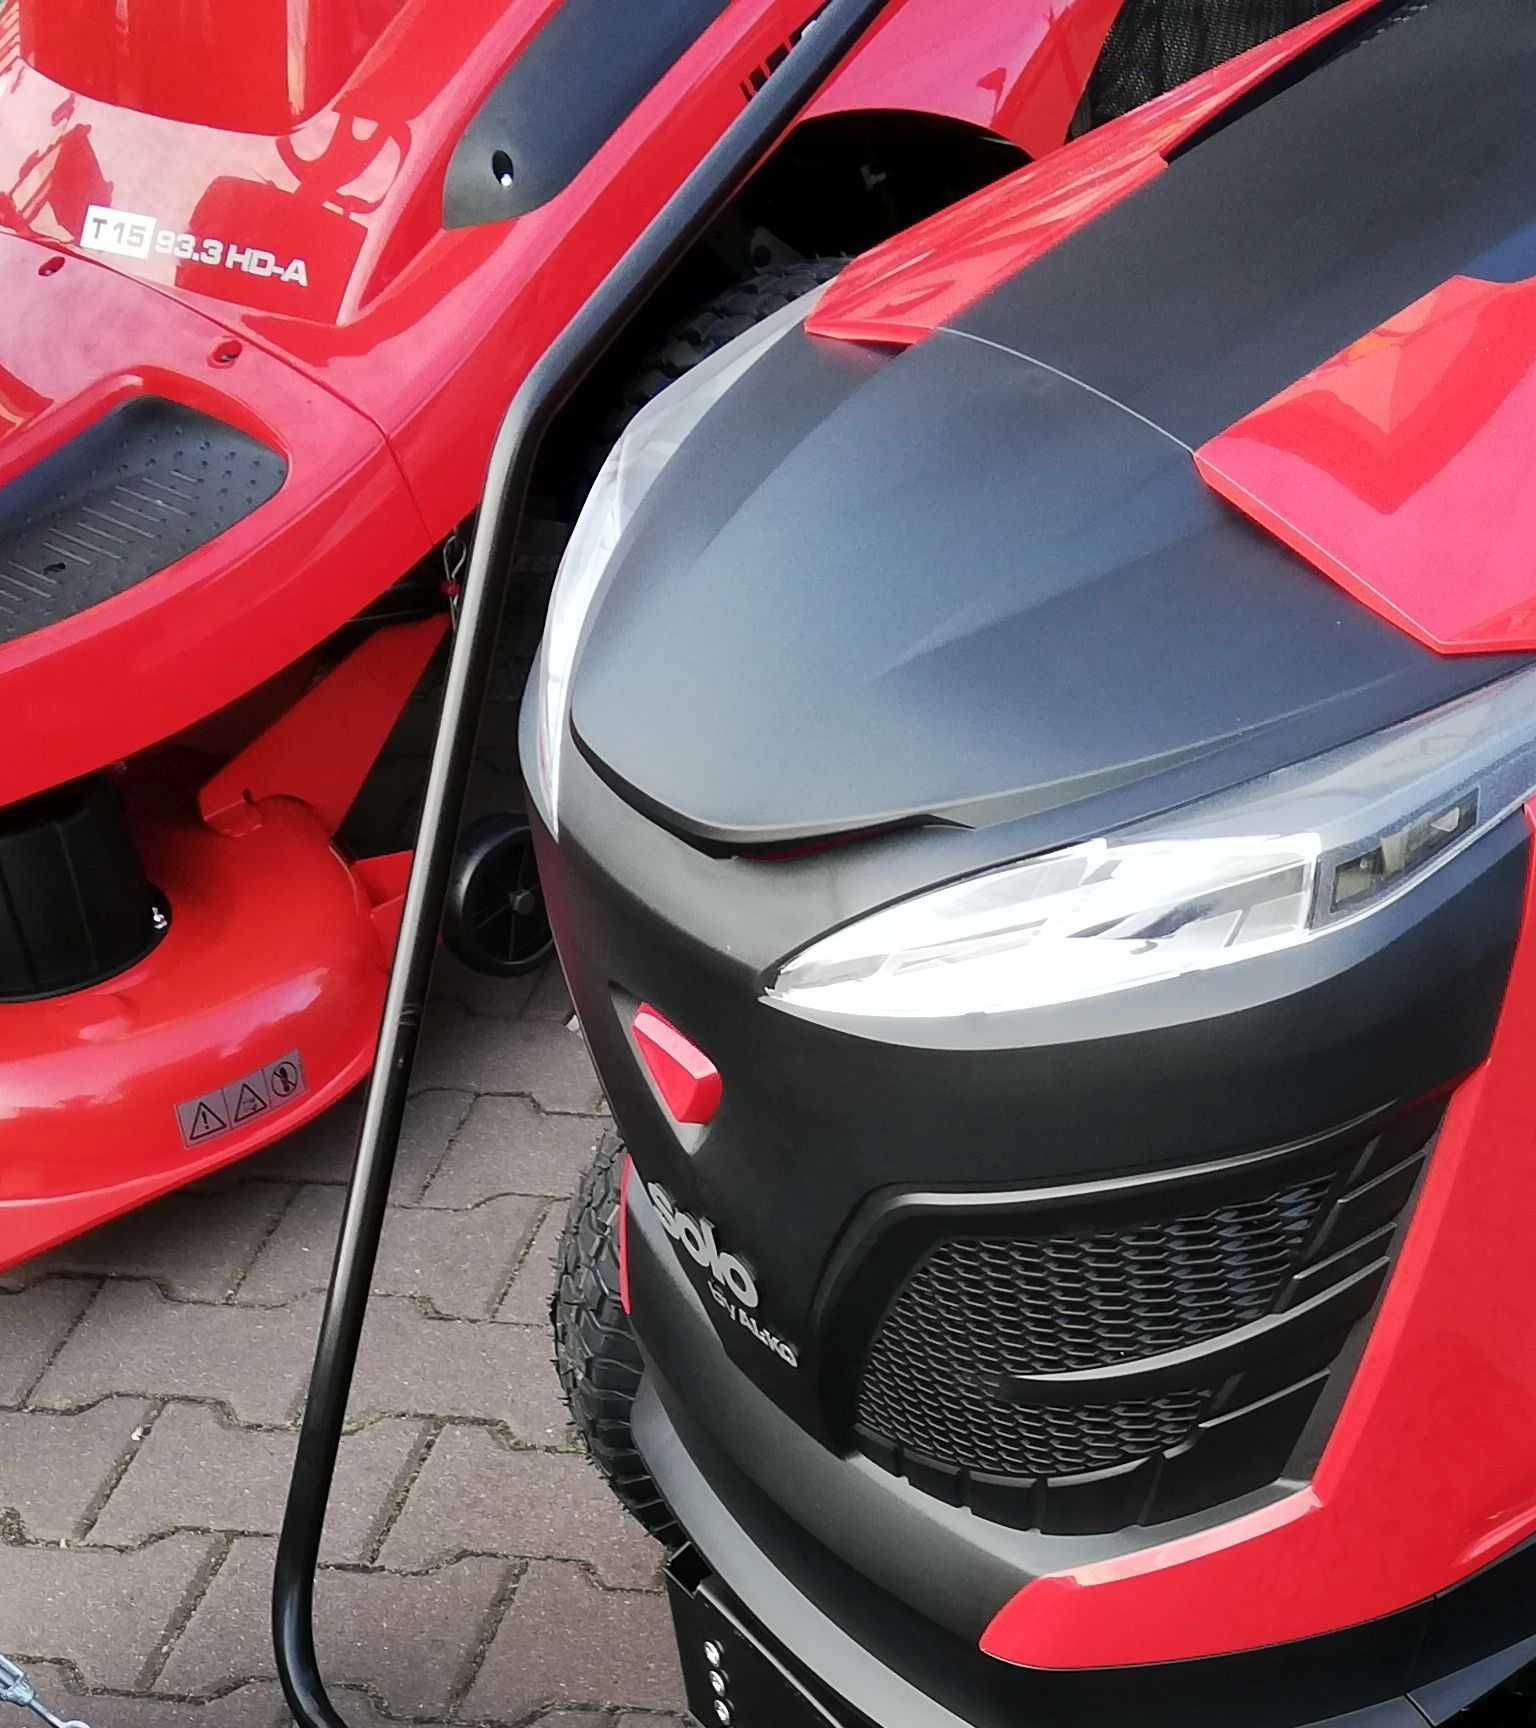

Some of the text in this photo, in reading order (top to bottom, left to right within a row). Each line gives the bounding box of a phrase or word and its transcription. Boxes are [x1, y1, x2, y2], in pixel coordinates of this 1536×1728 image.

[92, 217, 309, 287] T 15 93.3 HD-A
[648, 1182, 759, 1308] solo
